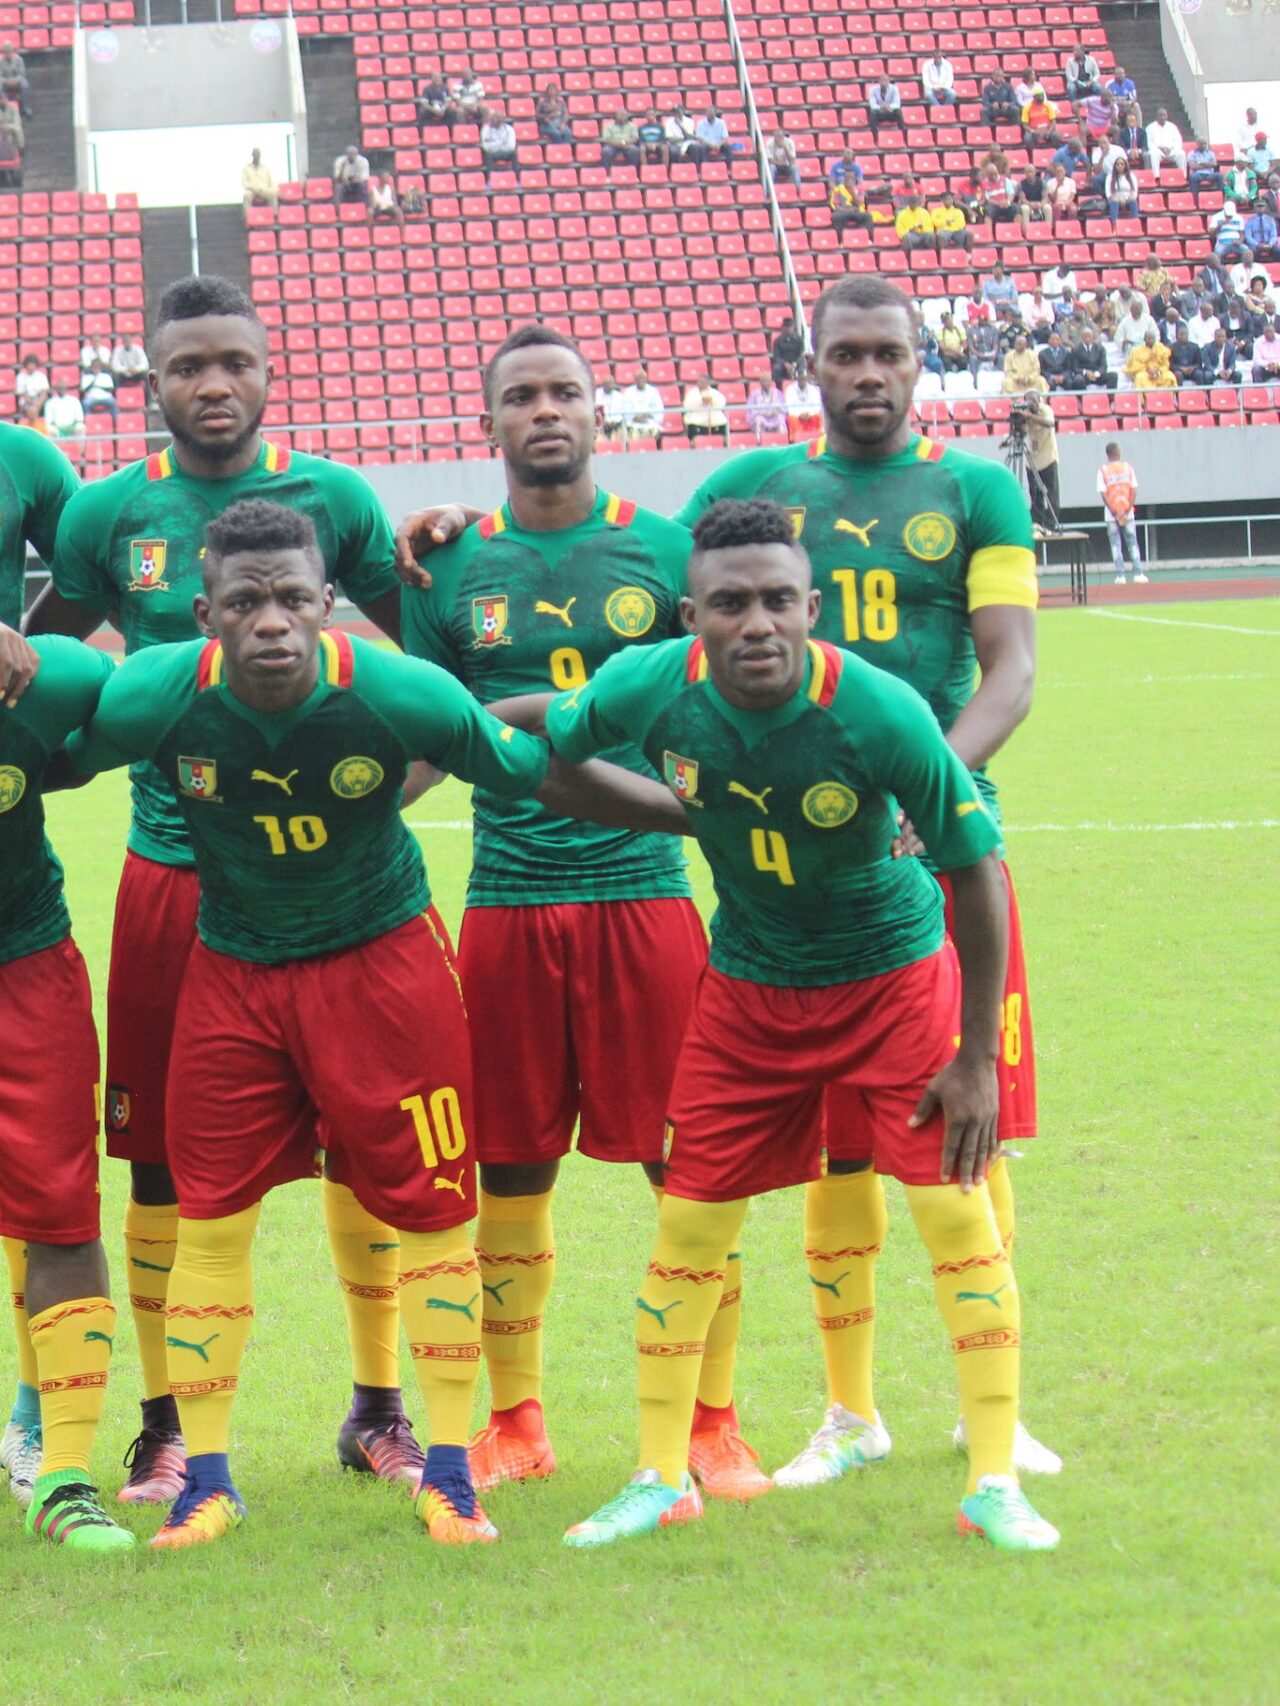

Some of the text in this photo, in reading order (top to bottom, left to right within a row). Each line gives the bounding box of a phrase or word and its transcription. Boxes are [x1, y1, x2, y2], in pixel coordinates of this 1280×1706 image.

[831, 568, 899, 643] 18
[550, 647, 588, 690] 9
[252, 814, 328, 856] 10
[750, 828, 796, 886] 4
[999, 992, 1023, 1067] 8
[400, 1086, 467, 1168] 10
